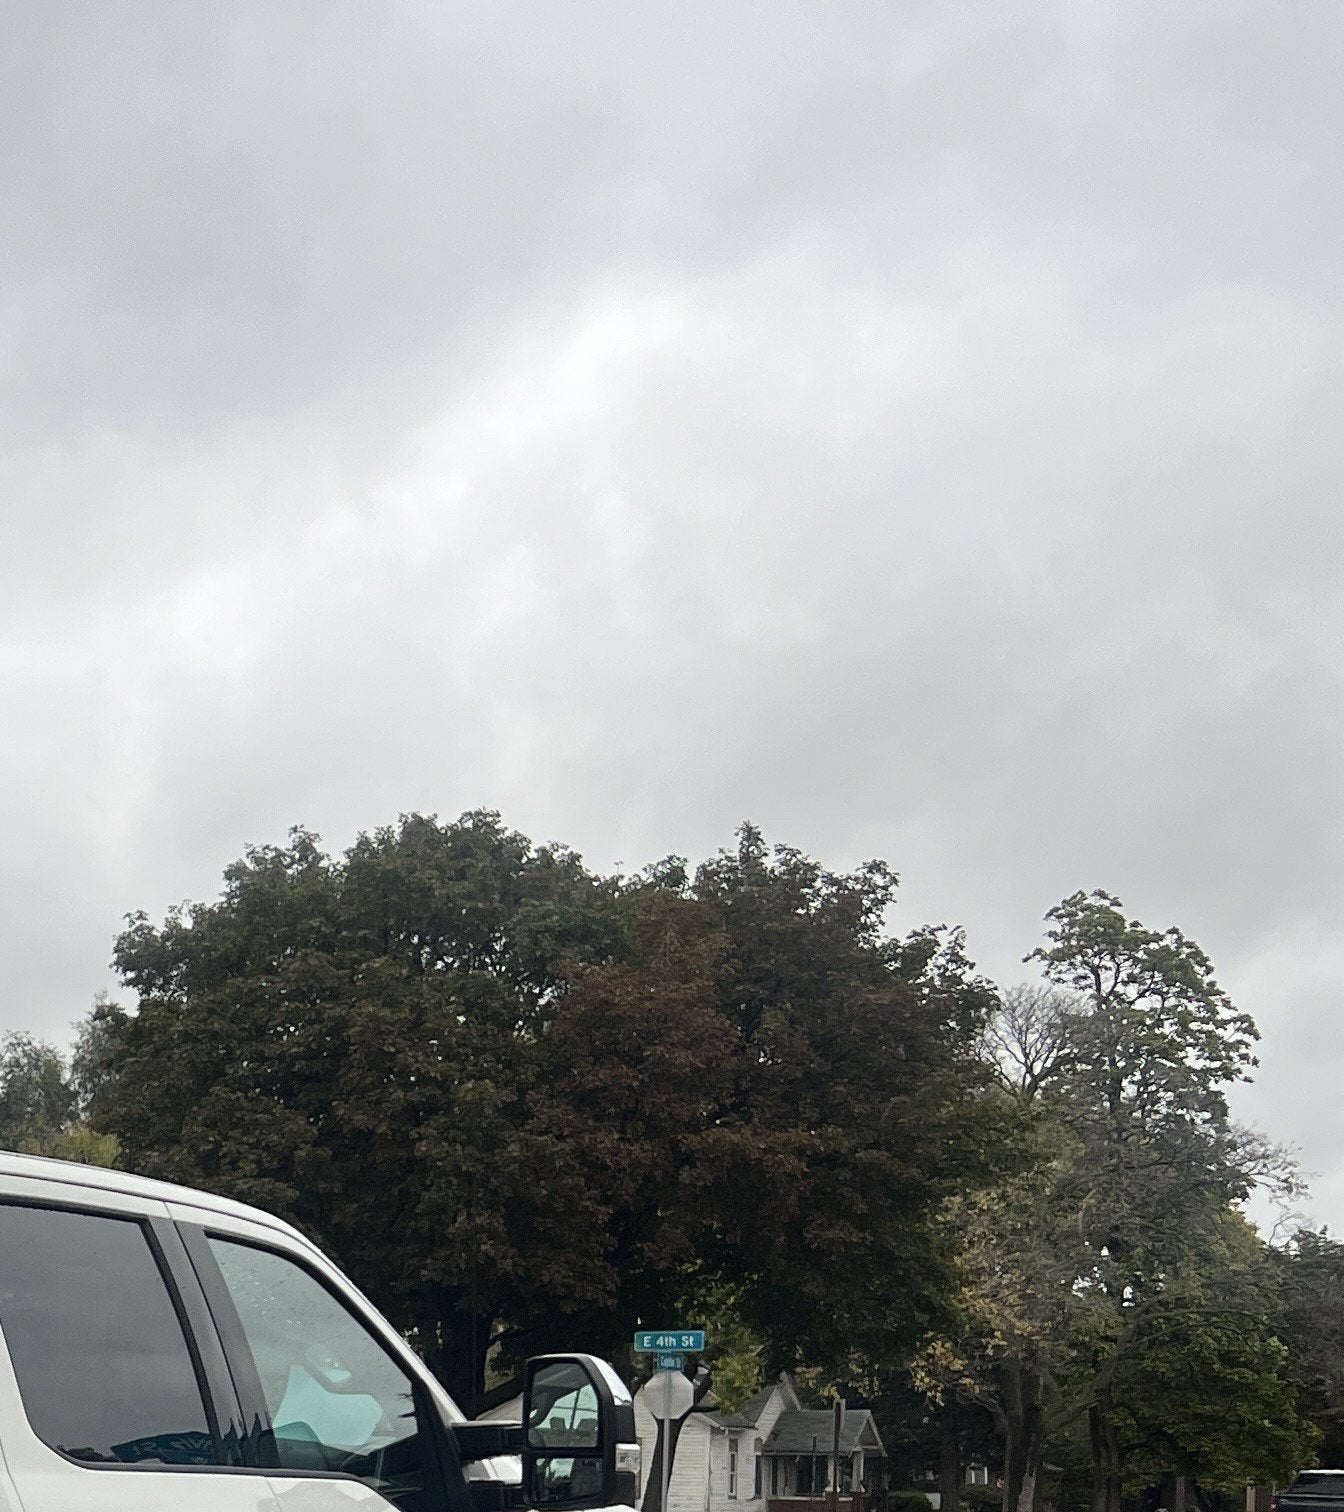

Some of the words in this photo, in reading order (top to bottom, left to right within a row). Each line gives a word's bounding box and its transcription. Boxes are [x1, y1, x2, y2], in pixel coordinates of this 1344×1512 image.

[643, 1335, 652, 1347] E
[656, 1335, 677, 1347] 4th
[681, 1335, 694, 1347] St
